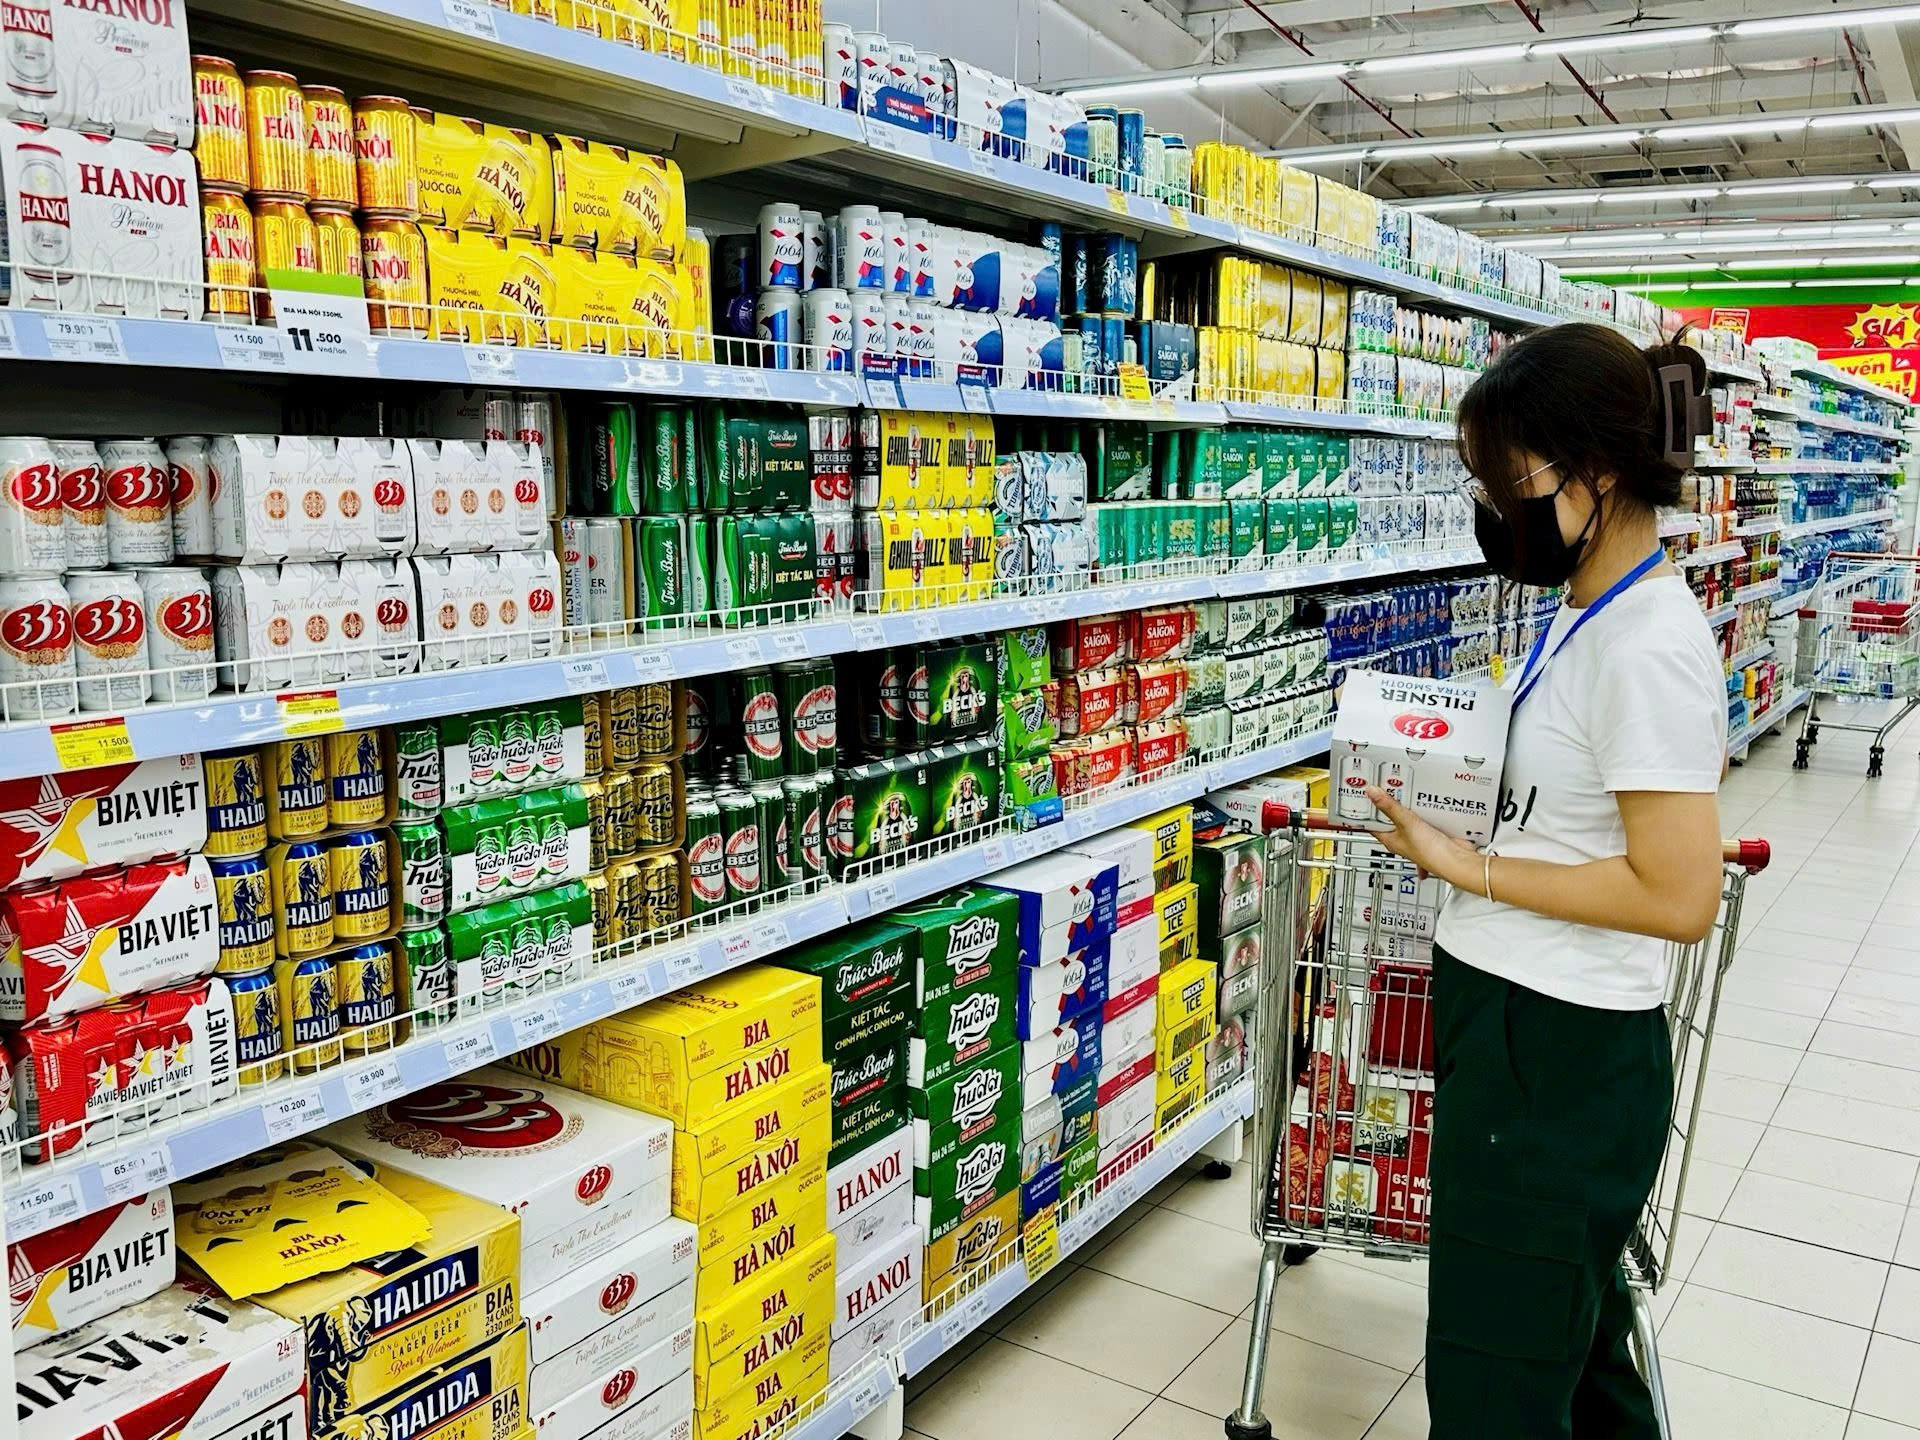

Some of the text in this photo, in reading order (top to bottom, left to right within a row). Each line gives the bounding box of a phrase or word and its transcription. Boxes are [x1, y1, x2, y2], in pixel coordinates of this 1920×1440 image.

[95, 19, 149, 47] Premium
[502, 160, 520, 182] BIA
[77, 162, 189, 208] HANOI
[477, 165, 525, 216] HÀ NỘI
[20, 198, 68, 222] HANOI
[111, 204, 164, 232] Premium
[130, 229, 147, 237] BEER
[774, 245, 801, 258] 1664
[955, 273, 972, 283] 1664
[499, 281, 521, 301] HÀ
[283, 306, 296, 314] BIA
[322, 310, 343, 319] 330ML
[287, 327, 314, 352] 11
[1862, 317, 1907, 341] GIÁ
[234, 334, 263, 346] 11.500
[1157, 350, 1178, 361] SAIGON
[765, 459, 805, 474] KIỆT TÁC BIA
[1111, 451, 1131, 461] SAIGON
[1223, 453, 1244, 462] SAIGON
[1266, 454, 1284, 463] SAIGON
[268, 471, 356, 486] Triple The Excellence
[814, 465, 832, 475] ICE
[378, 479, 402, 504] 333
[574, 567, 582, 599] SMOOTH
[776, 570, 814, 584] KIỆT TÁC BIA
[271, 597, 359, 614] Triple The Excellence
[378, 598, 404, 624] 333
[14, 599, 66, 648] 333
[84, 593, 138, 642] 333
[1231, 611, 1253, 624] SAIGON
[1083, 632, 1112, 649] SAIGON
[1147, 624, 1176, 641] SAIGON
[573, 663, 593, 673] 13.900
[1380, 678, 1477, 698] EXTRA SMOOTH
[943, 690, 987, 714] BECK'S
[1380, 687, 1476, 711] PILSNER
[97, 737, 129, 749] 11.500
[638, 731, 670, 742] GOLD
[1454, 772, 1476, 783] MỚI
[1338, 787, 1367, 796] PILSNE
[1416, 791, 1488, 812] PILSNER
[96, 780, 200, 827] BIA VIỆT
[945, 797, 989, 823] BECK'S
[1415, 801, 1488, 817] EXTRA SMOOTH
[137, 828, 174, 841] HEINEKEN
[870, 816, 919, 846] BECK'S
[1157, 821, 1181, 839] BECK'S
[1161, 836, 1178, 854] ICE
[1163, 899, 1187, 918] BECK'S
[118, 903, 214, 956] BIA VIỆT
[220, 916, 275, 947] HALIDA
[1168, 914, 1184, 933] ICE
[1380, 916, 1427, 932] PILSNER
[949, 918, 997, 955] huda
[155, 952, 190, 966] HEINEKEN
[836, 946, 904, 993] Trúc Bạch
[617, 977, 637, 989] 13.200
[1182, 979, 1205, 1000] BECK'S
[1186, 993, 1202, 1014] ICE
[206, 1008, 230, 1043] VIỆT
[524, 1014, 545, 1027] 72.900
[850, 1001, 891, 1029] KIỆT TÁC
[890, 1011, 905, 1025] CAO
[951, 995, 997, 1035] huda
[744, 1018, 770, 1049] BIA
[455, 1037, 478, 1052] 12.500
[691, 1048, 715, 1063] HABECO
[859, 1048, 895, 1081] Bạch
[359, 1068, 385, 1084] 58.900
[725, 1047, 790, 1102] HÀ NỘI
[956, 1071, 1000, 1112] huda
[279, 1099, 306, 1114] 10.200
[842, 1100, 881, 1131] KIỆT TÁC
[754, 1110, 782, 1142] BIA
[647, 1131, 668, 1147] 24 LON
[704, 1143, 727, 1161] HABECO
[737, 1137, 800, 1196] HÀ NỘI
[582, 1165, 612, 1194] 333
[836, 1150, 903, 1215] HANOI
[1392, 1173, 1408, 1186] 63
[20, 1191, 54, 1211] 11.500
[1391, 1191, 1404, 1211] 1
[751, 1197, 779, 1231] BIA
[290, 1232, 316, 1245] BIA
[551, 1236, 578, 1261] Triple
[579, 1228, 596, 1248] The
[594, 1207, 633, 1237] Excellence
[702, 1235, 725, 1253] HABECO
[279, 1233, 347, 1260] HÀ NỘI
[733, 1223, 796, 1286] HÀ NỘI
[67, 1226, 170, 1295] BIA VIỆT
[105, 1278, 143, 1298] HEINEKEN
[373, 1258, 468, 1330] HALIDA
[846, 1254, 912, 1323] HANOI
[485, 1282, 514, 1316] BIA
[762, 1288, 788, 1323] BIA
[485, 1303, 515, 1328] 24 CANS
[485, 1315, 515, 1338] x330 ml
[277, 1342, 291, 1357] 24
[391, 1333, 428, 1361] LAGER
[433, 1319, 461, 1341] BEER
[713, 1329, 735, 1349] HABECO
[743, 1312, 805, 1378] HÀ NỘI
[243, 1369, 295, 1401] HEINEKEN
[390, 1371, 481, 1440] HALIDA
[491, 1388, 521, 1423] BIA
